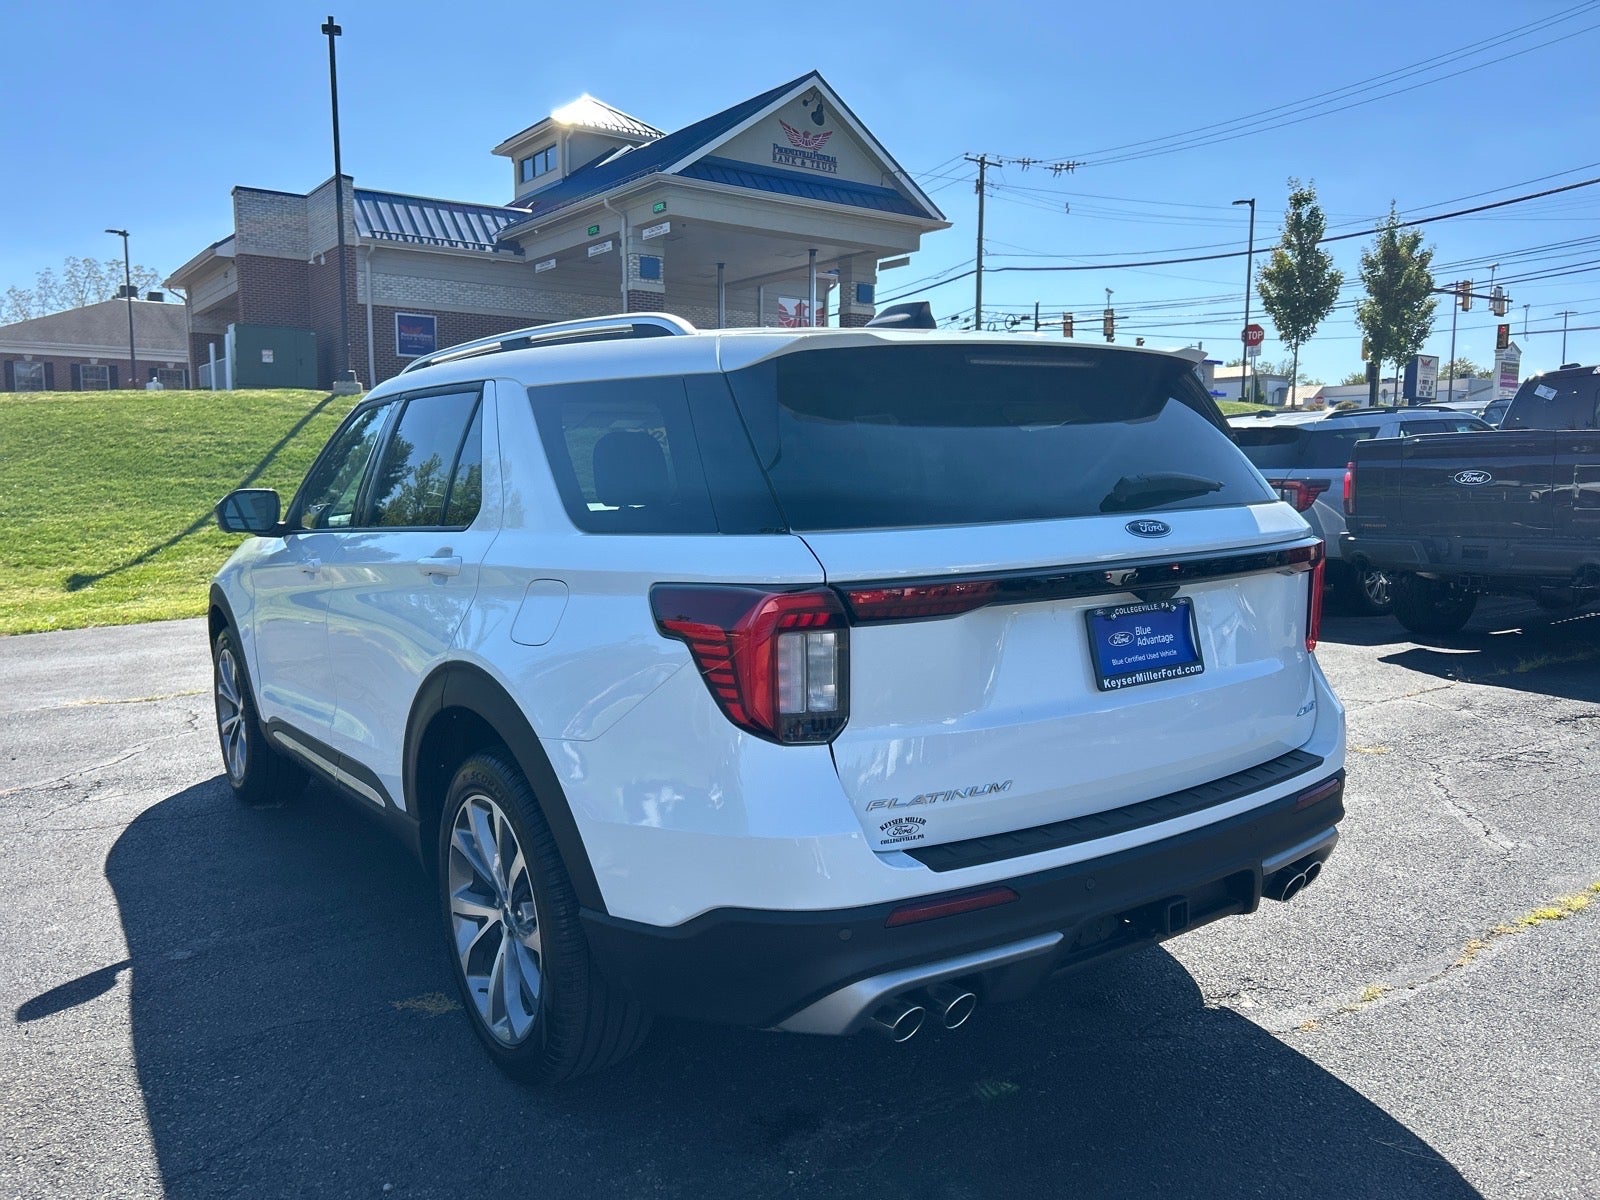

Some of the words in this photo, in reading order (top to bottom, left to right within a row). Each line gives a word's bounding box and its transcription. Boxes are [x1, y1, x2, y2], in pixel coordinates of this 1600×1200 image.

[773, 153, 797, 166] BANK
[810, 160, 838, 172] TRUST
[1460, 472, 1485, 482] Ford
[1138, 521, 1165, 533] Ford
[1114, 604, 1160, 616] COLLEGEVILLE,
[1135, 626, 1152, 636] Blue
[1113, 633, 1131, 645] Ford
[1137, 633, 1174, 647] Advantage
[1112, 658, 1124, 666] Blue
[1124, 653, 1146, 664] Certified
[1147, 651, 1160, 660] Used
[1159, 649, 1178, 658] Vehicle
[1103, 664, 1203, 689] KeyserMillerFord.com
[866, 780, 1013, 811] PLATINUM
[879, 817, 903, 831] KEYSER
[904, 816, 927, 826] MILLER
[892, 825, 914, 836] Ford
